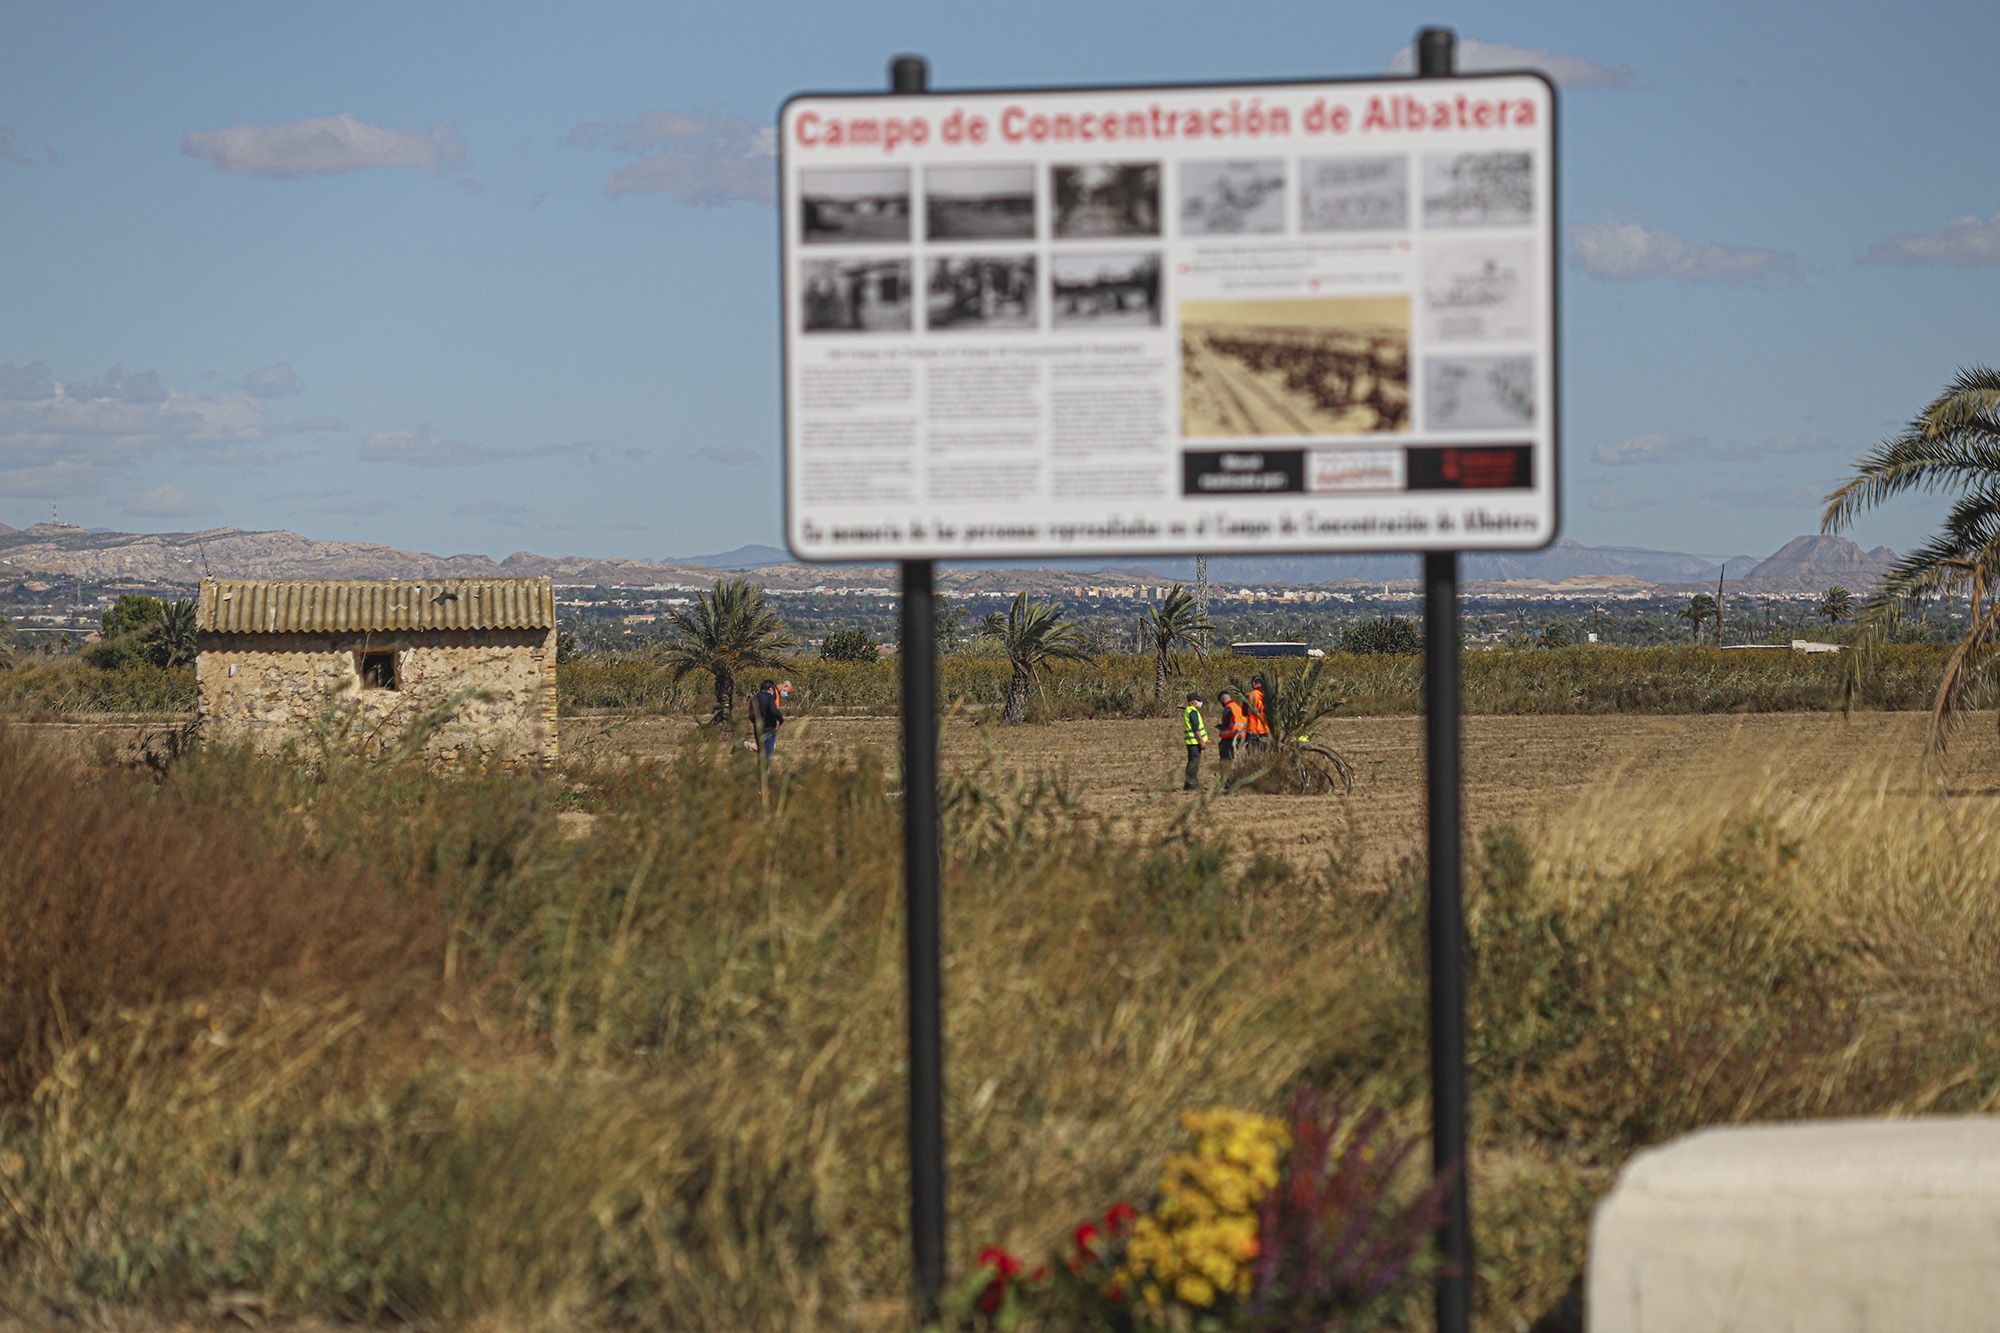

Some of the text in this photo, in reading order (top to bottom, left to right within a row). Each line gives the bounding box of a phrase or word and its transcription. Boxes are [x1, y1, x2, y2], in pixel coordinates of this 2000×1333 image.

[796, 94, 1537, 153] Campo de Concentración de Albatera
